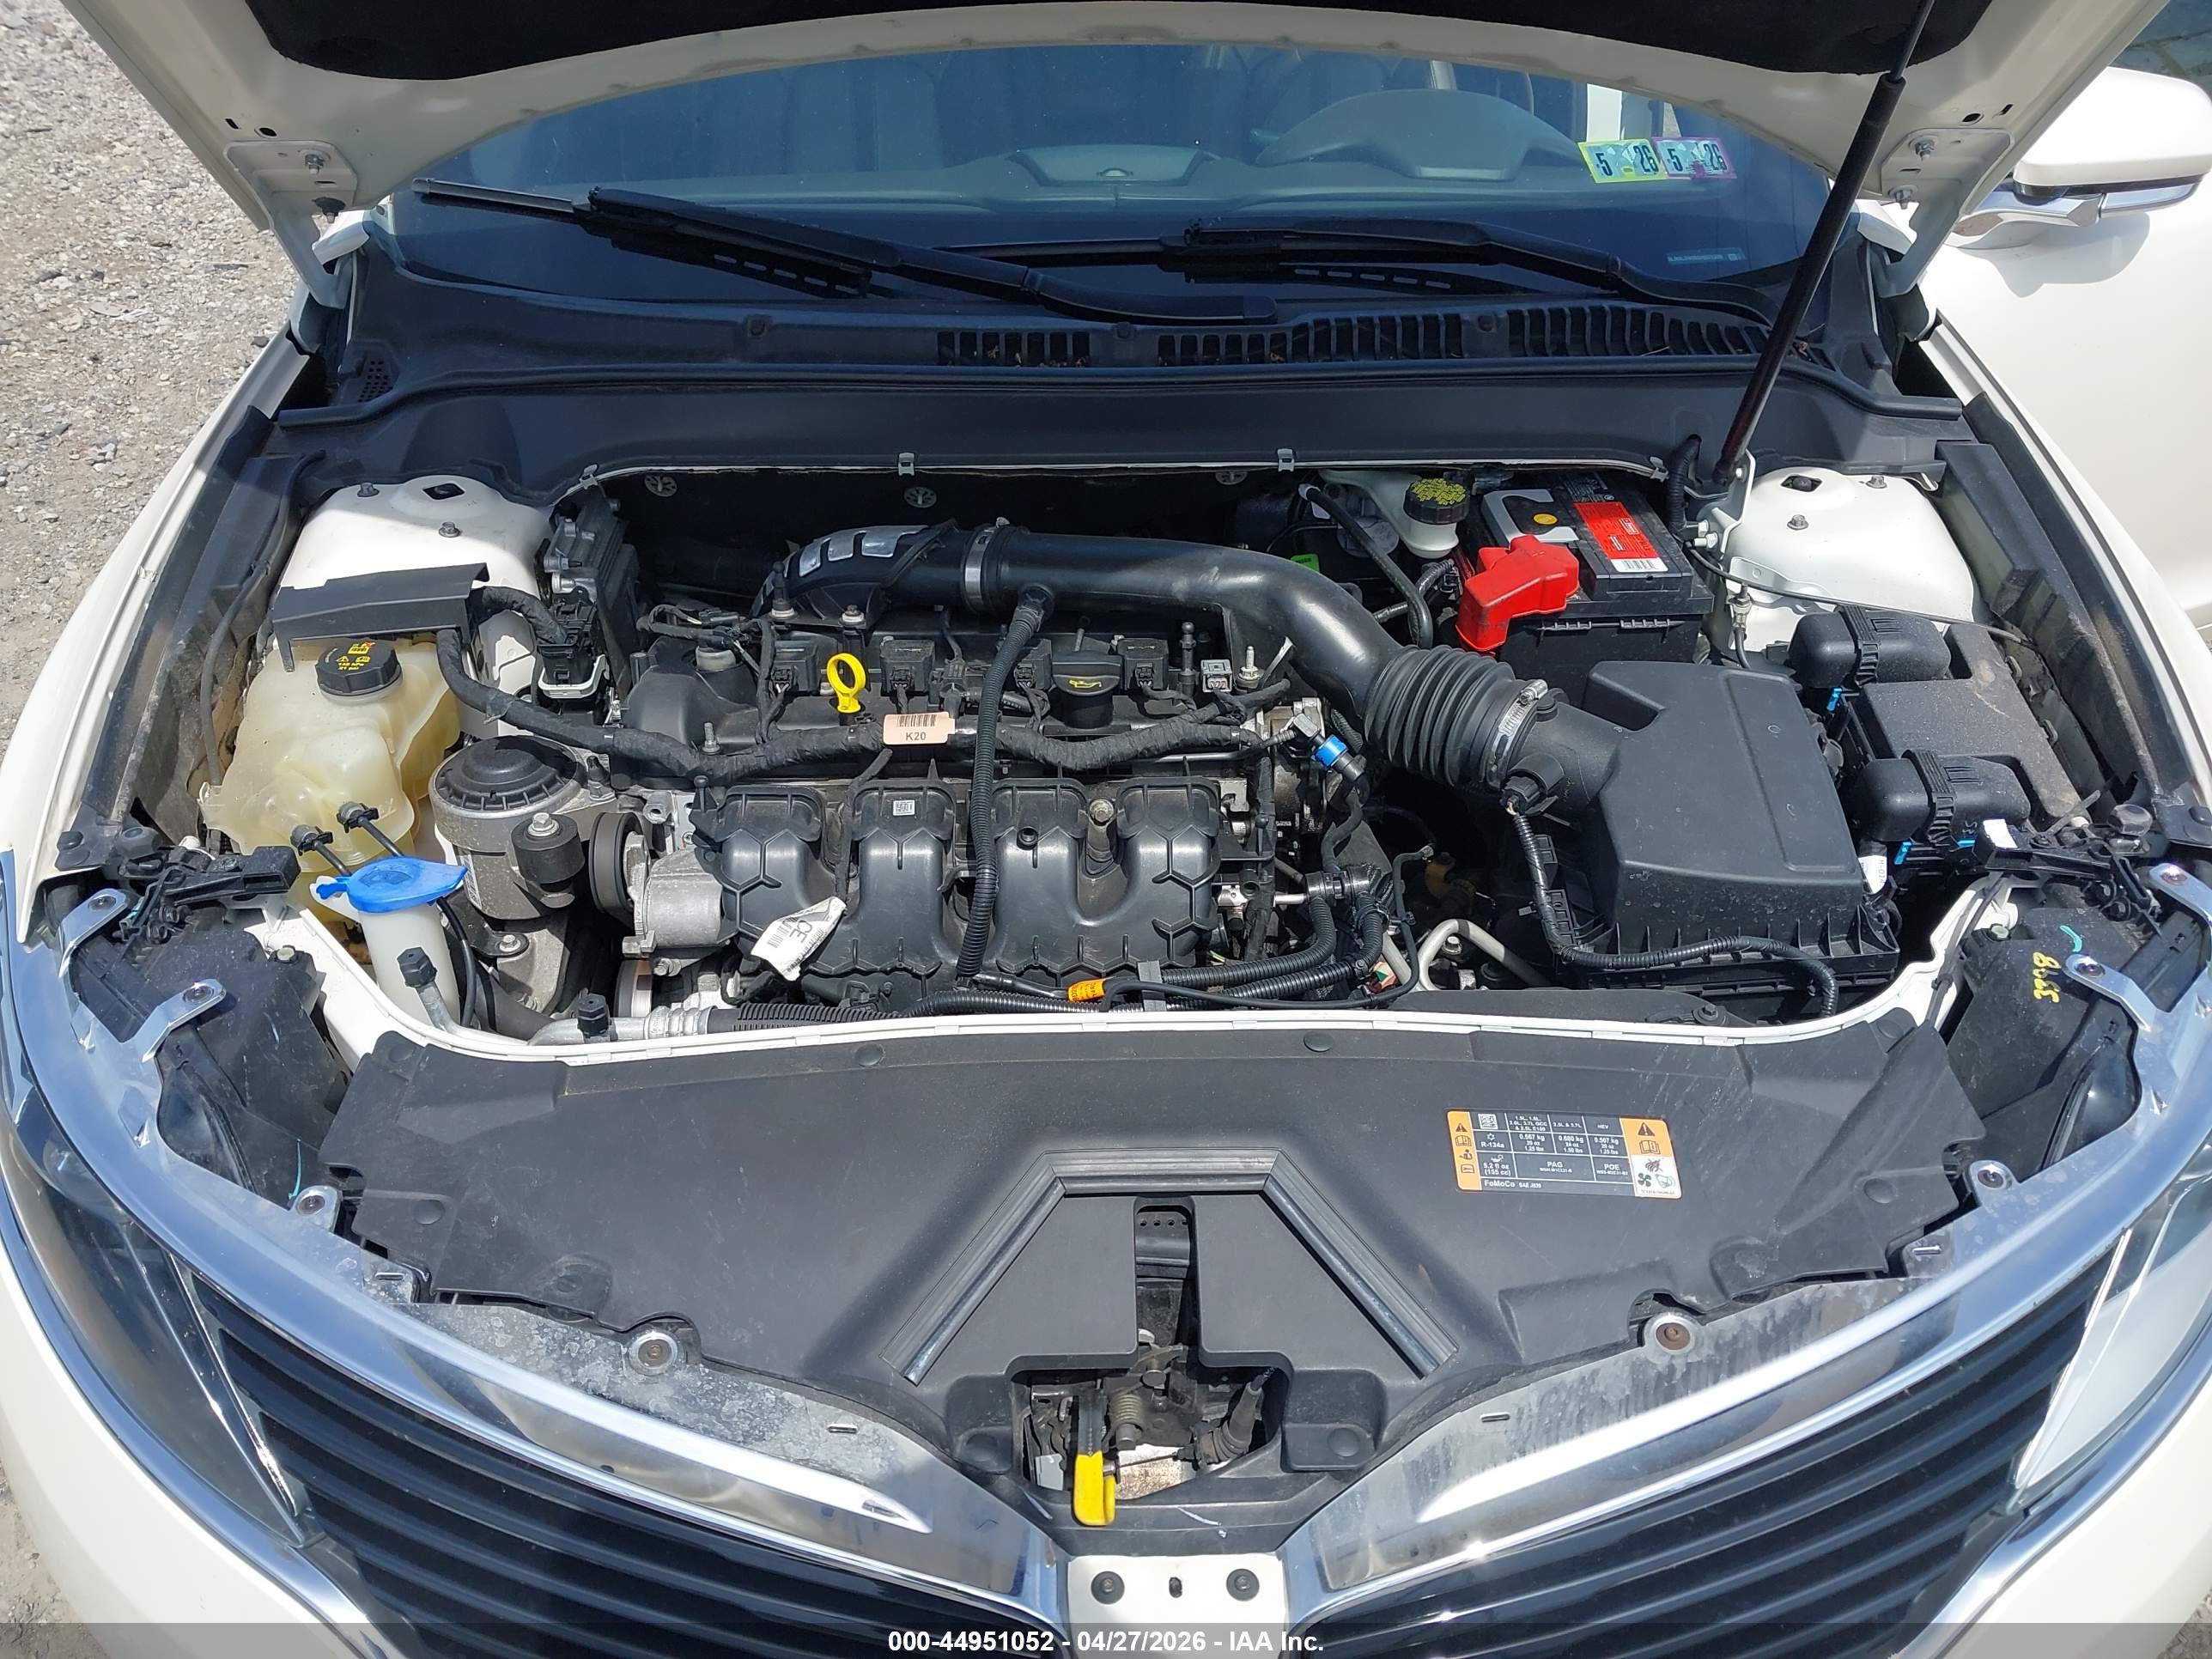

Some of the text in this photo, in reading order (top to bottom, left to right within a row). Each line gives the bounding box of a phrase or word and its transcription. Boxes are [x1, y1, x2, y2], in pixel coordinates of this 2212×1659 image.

[1595, 144, 1659, 177] 5 26
[1667, 149, 1684, 173] 5
[906, 732, 927, 741] K20
